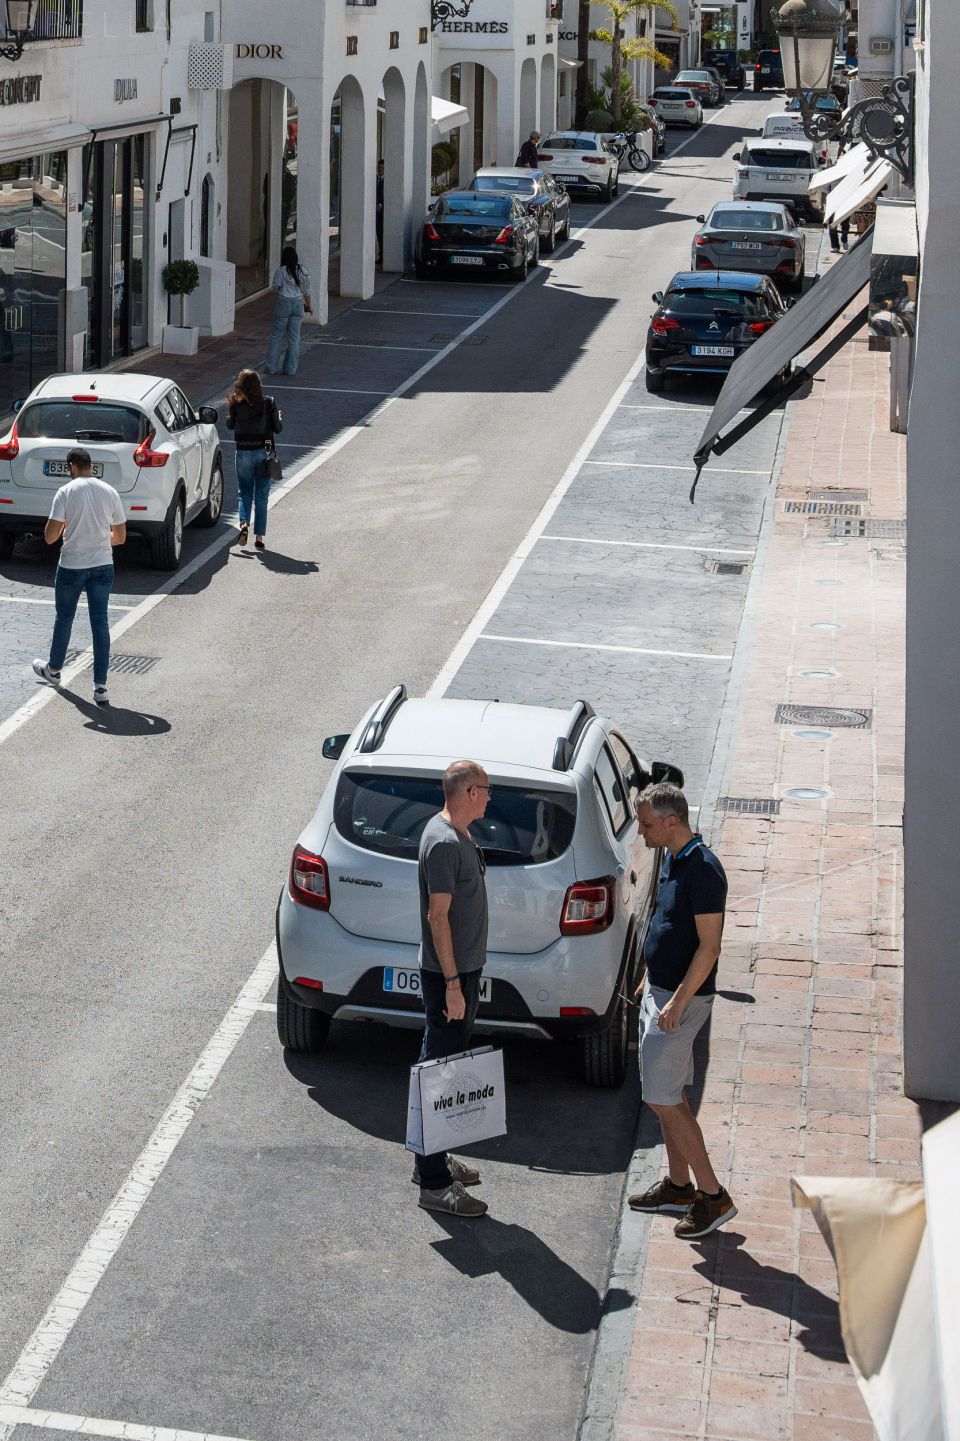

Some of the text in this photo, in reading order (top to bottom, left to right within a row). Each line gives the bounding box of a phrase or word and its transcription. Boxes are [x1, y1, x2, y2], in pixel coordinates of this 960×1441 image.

[235, 43, 284, 60] DIOR
[697, 346, 733, 356] 3194 KGH
[339, 876, 384, 889] SANDERO
[397, 971, 420, 991] 06
[433, 1084, 495, 1111] viva la moda
